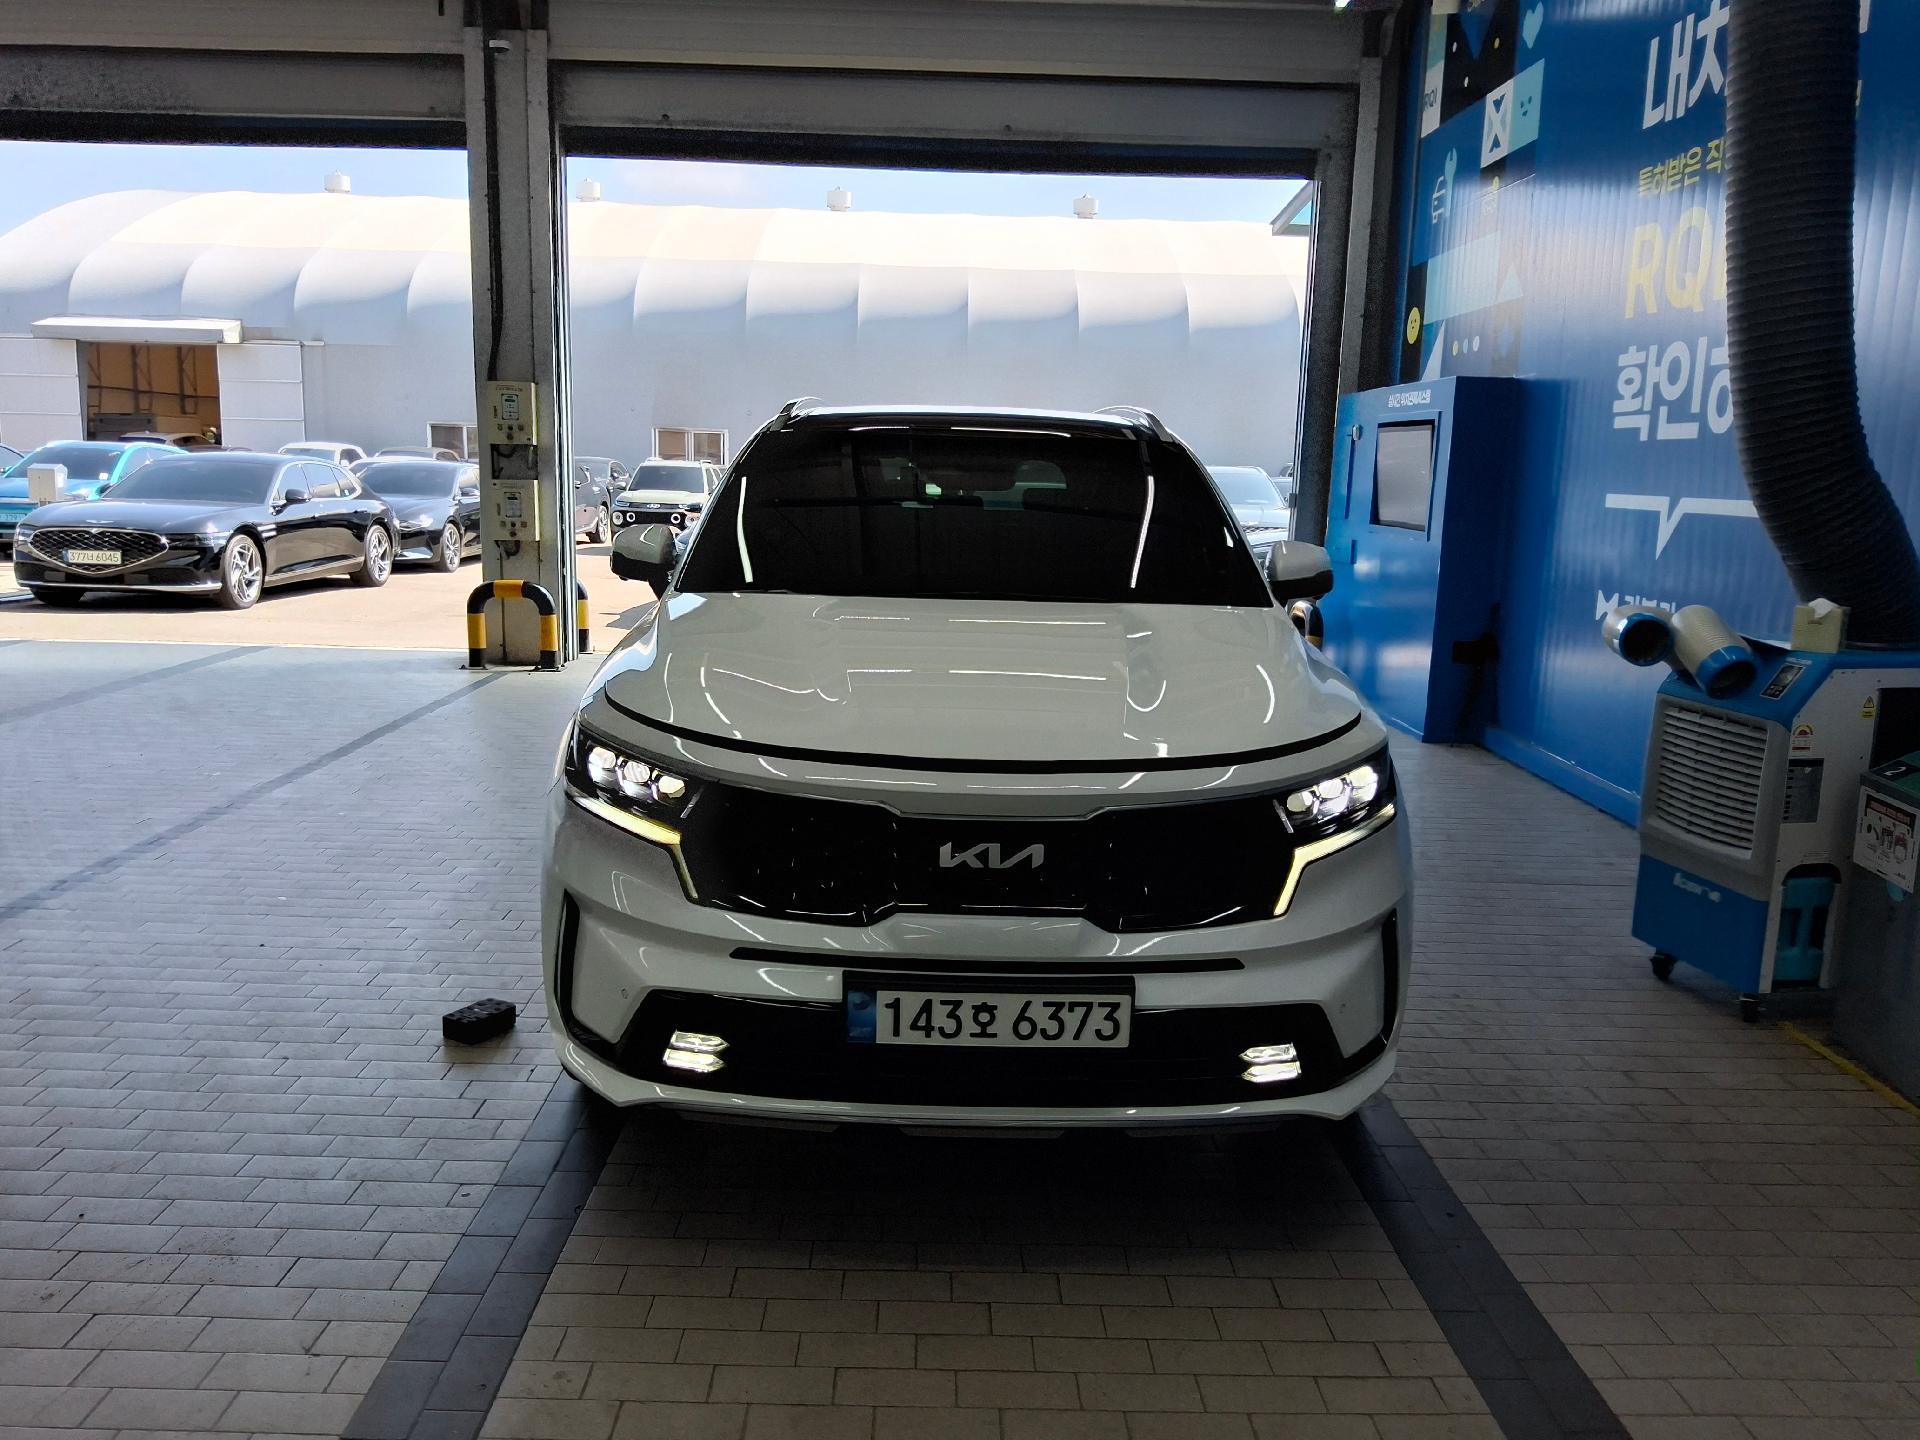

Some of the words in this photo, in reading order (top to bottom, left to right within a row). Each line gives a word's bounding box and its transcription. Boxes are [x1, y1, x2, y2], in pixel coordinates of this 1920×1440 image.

[1638, 146, 1702, 197] 특허받은
[1705, 137, 1727, 174] 직
[95, 552, 119, 562] 6045
[939, 842, 1045, 869] KIA
[884, 996, 998, 1040] 143호
[1012, 999, 1122, 1042] 6373
